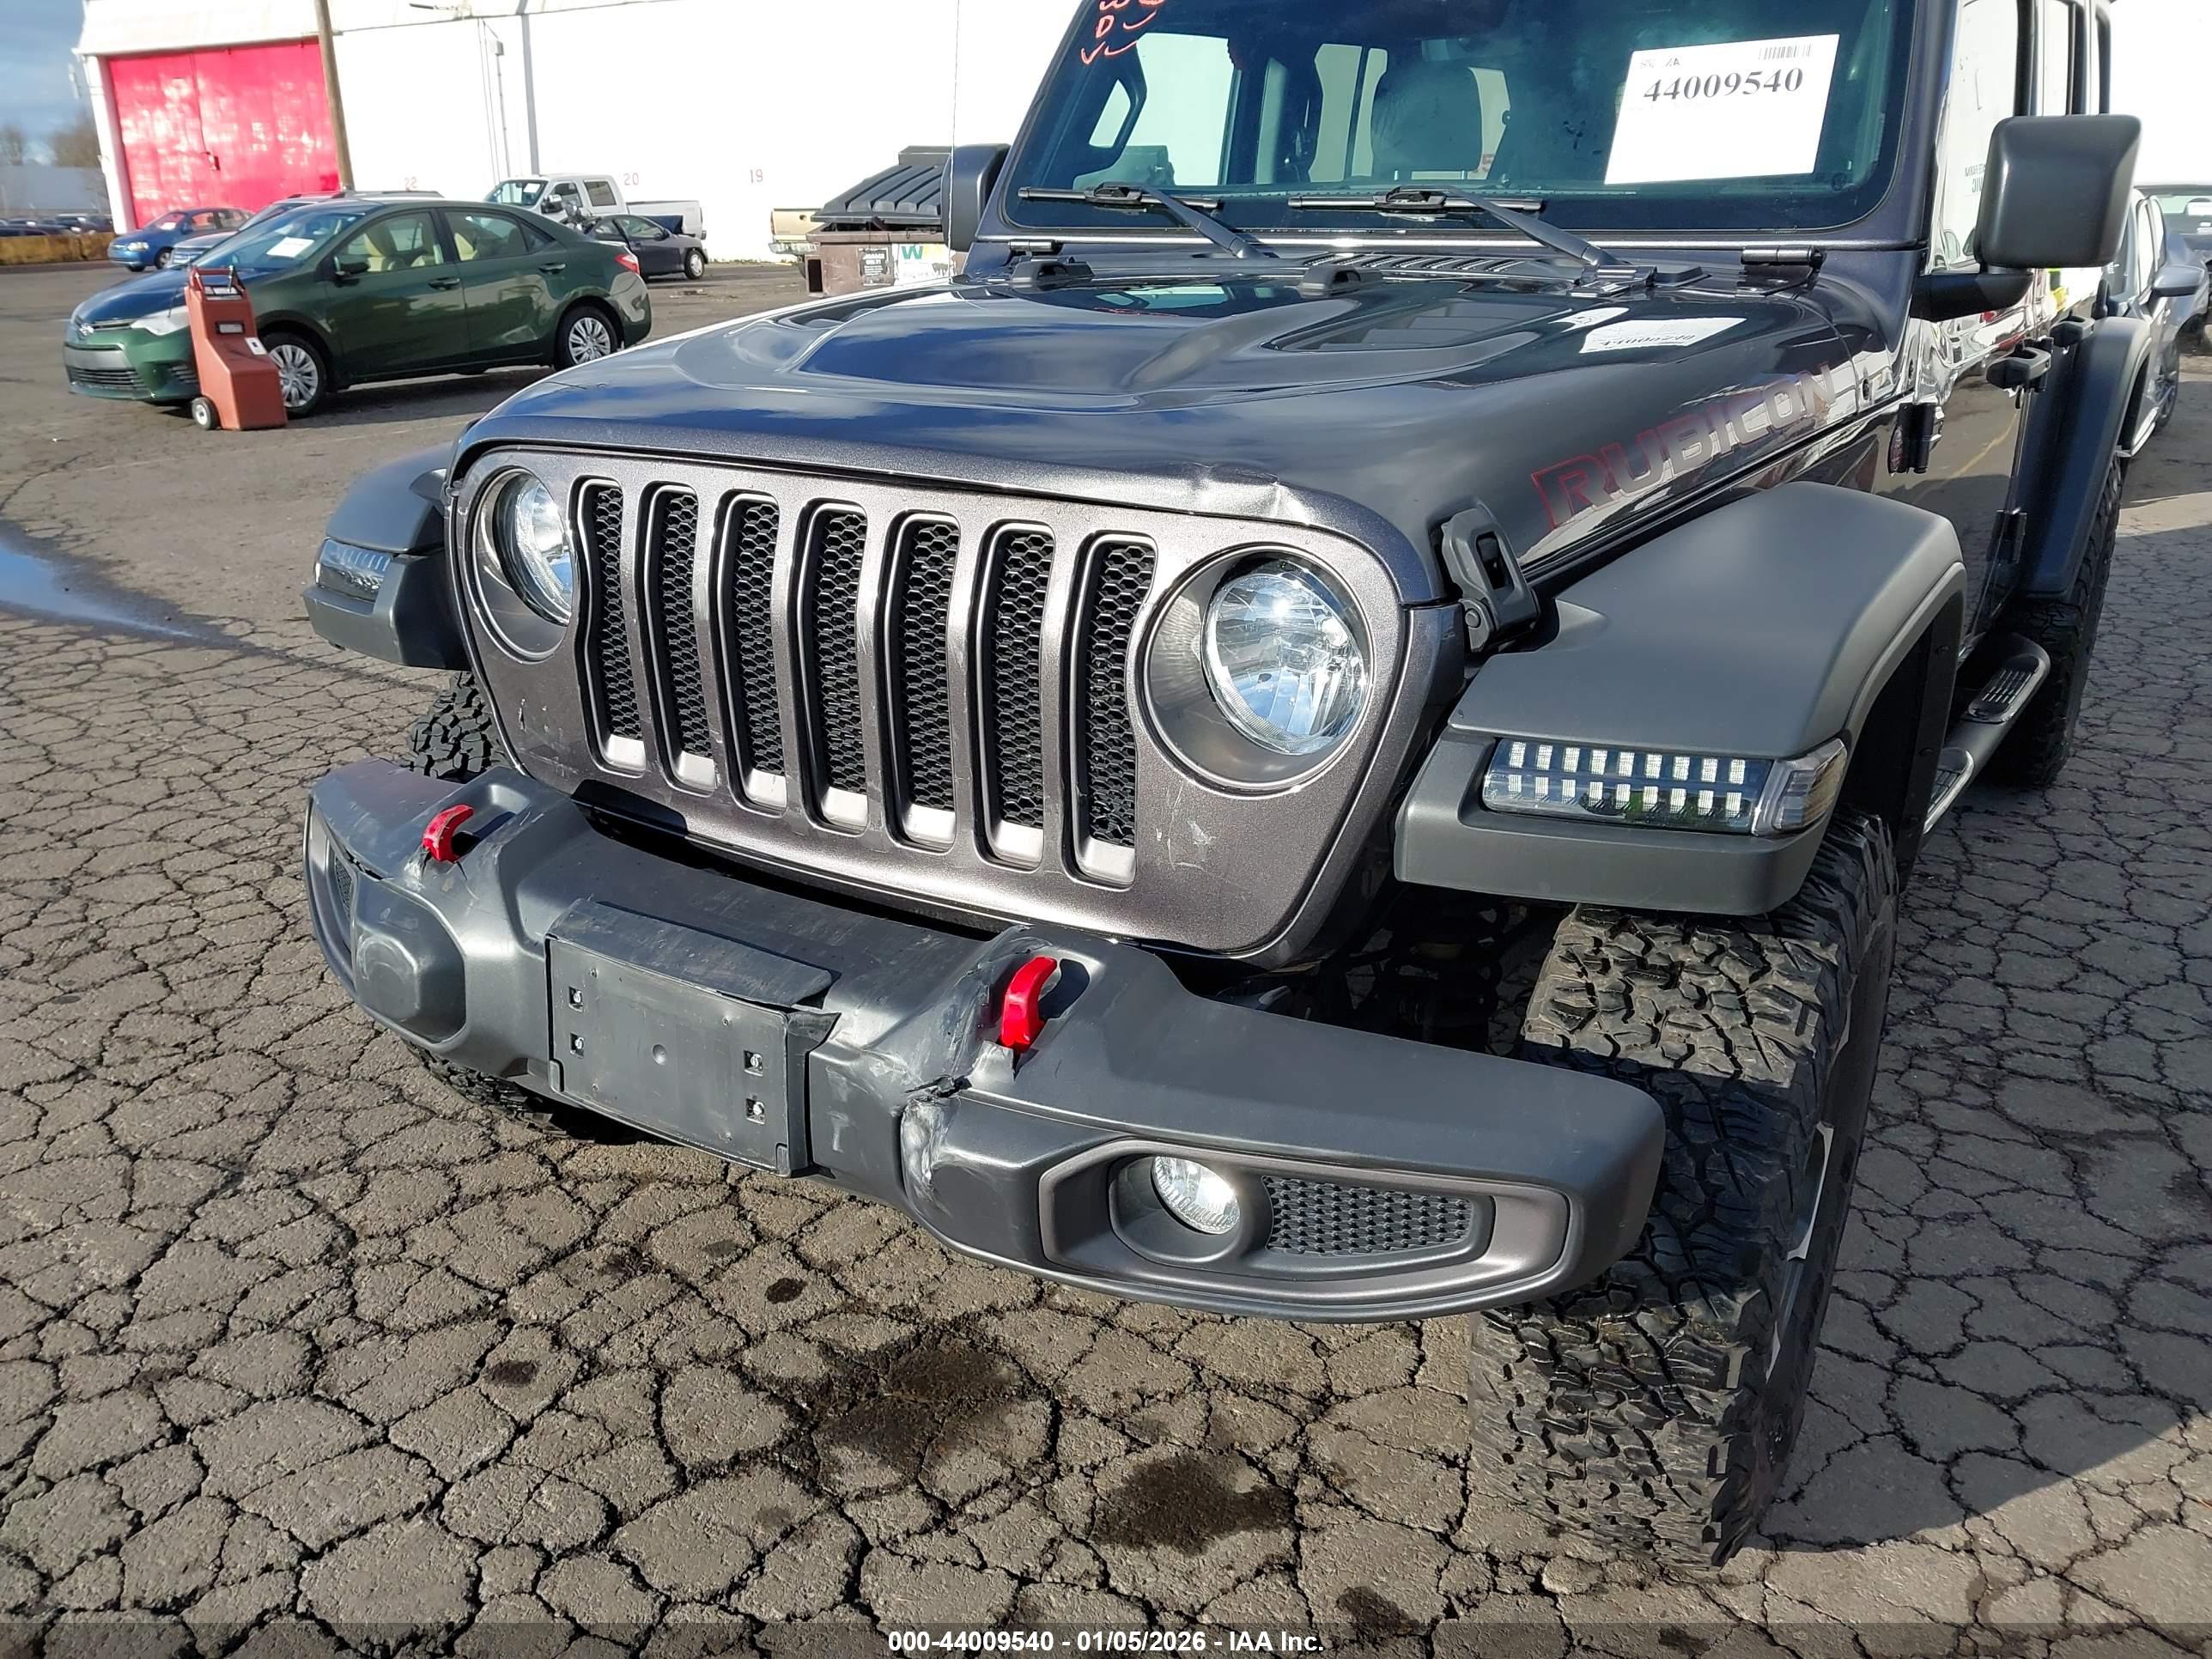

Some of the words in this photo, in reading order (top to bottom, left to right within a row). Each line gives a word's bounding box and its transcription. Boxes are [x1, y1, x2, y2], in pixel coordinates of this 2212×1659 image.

[1644, 67, 1803, 101] 44009540
[624, 173, 639, 185] 20
[750, 169, 763, 183] 19
[1531, 362, 1835, 530] RUBICON
